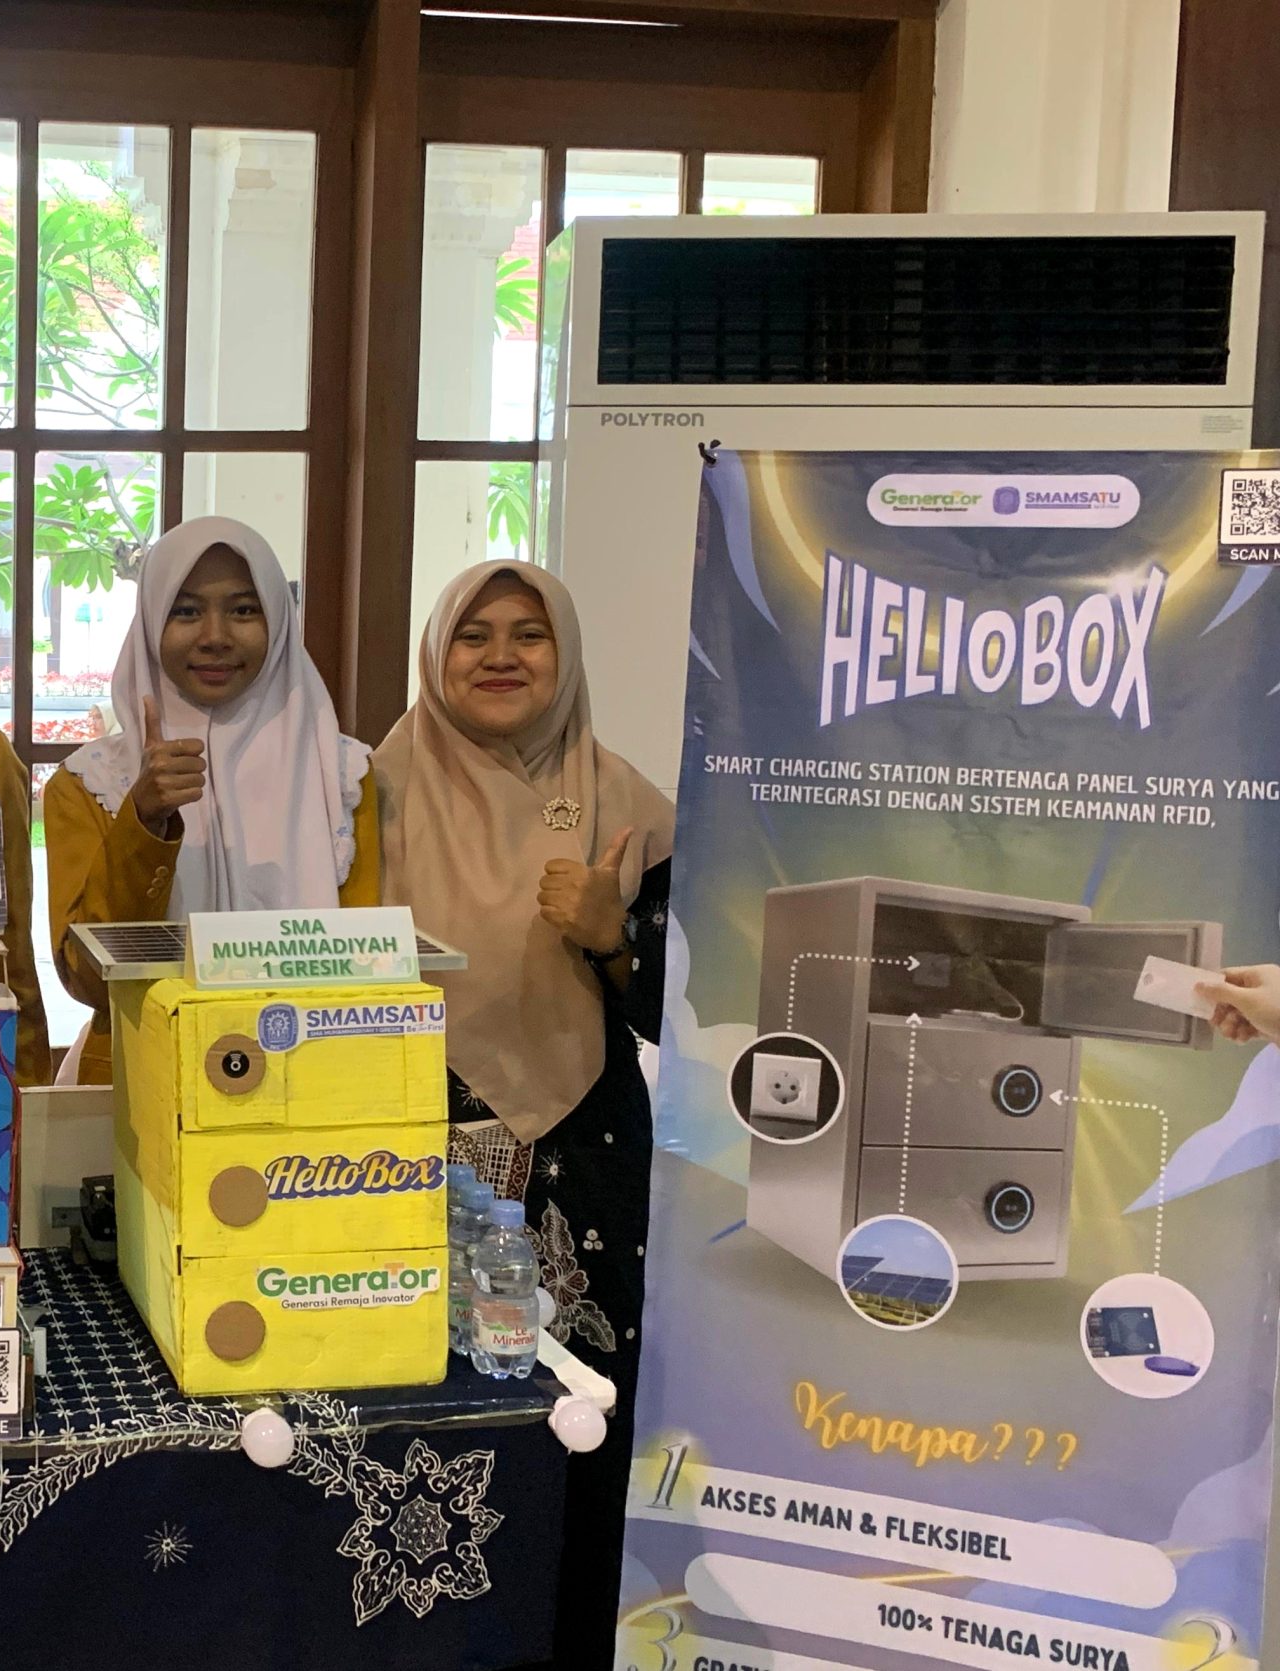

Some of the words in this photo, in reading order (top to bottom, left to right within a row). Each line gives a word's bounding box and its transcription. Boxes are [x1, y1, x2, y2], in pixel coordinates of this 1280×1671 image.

[601, 413, 704, 427] POLYTRON
[1026, 491, 1120, 503] SMAMSATU
[1229, 548, 1269, 561] SCAN
[820, 554, 1166, 730] HELIOBOX
[704, 755, 764, 775] SMART
[770, 758, 862, 780] CHARGING
[868, 763, 950, 785] STATION
[956, 767, 1069, 791] BERTENAGA
[1077, 773, 1138, 794] PANEL
[1145, 776, 1214, 798] SURYA
[1223, 780, 1279, 800] YANG
[749, 783, 881, 808] TERINTEGRASI
[887, 790, 964, 813] DENGAN
[970, 795, 1040, 817] SISTEM
[1047, 799, 1155, 823] KEAMANAN
[1163, 805, 1216, 828] RFID,
[280, 919, 326, 936] SMA
[212, 936, 397, 959] MUHAMMADIYAH
[263, 961, 271, 977] 1
[280, 959, 353, 978] GRESIK
[306, 1003, 444, 1028] SMAMSATU
[265, 1150, 446, 1200] HelioBox
[281, 1298, 328, 1310] Generasi
[331, 1295, 369, 1308] Remaja
[372, 1294, 415, 1305] Inovator
[515, 1326, 527, 1336] Le
[645, 1442, 689, 1511] 1
[701, 1486, 777, 1518] AKSES
[784, 1500, 852, 1531] AMAN
[860, 1512, 877, 1536] &
[886, 1517, 1012, 1561] FLEKSIBEL
[878, 1604, 933, 1632] 100%
[941, 1616, 1041, 1658] TENAGA
[1049, 1639, 1130, 1671] SURYA
